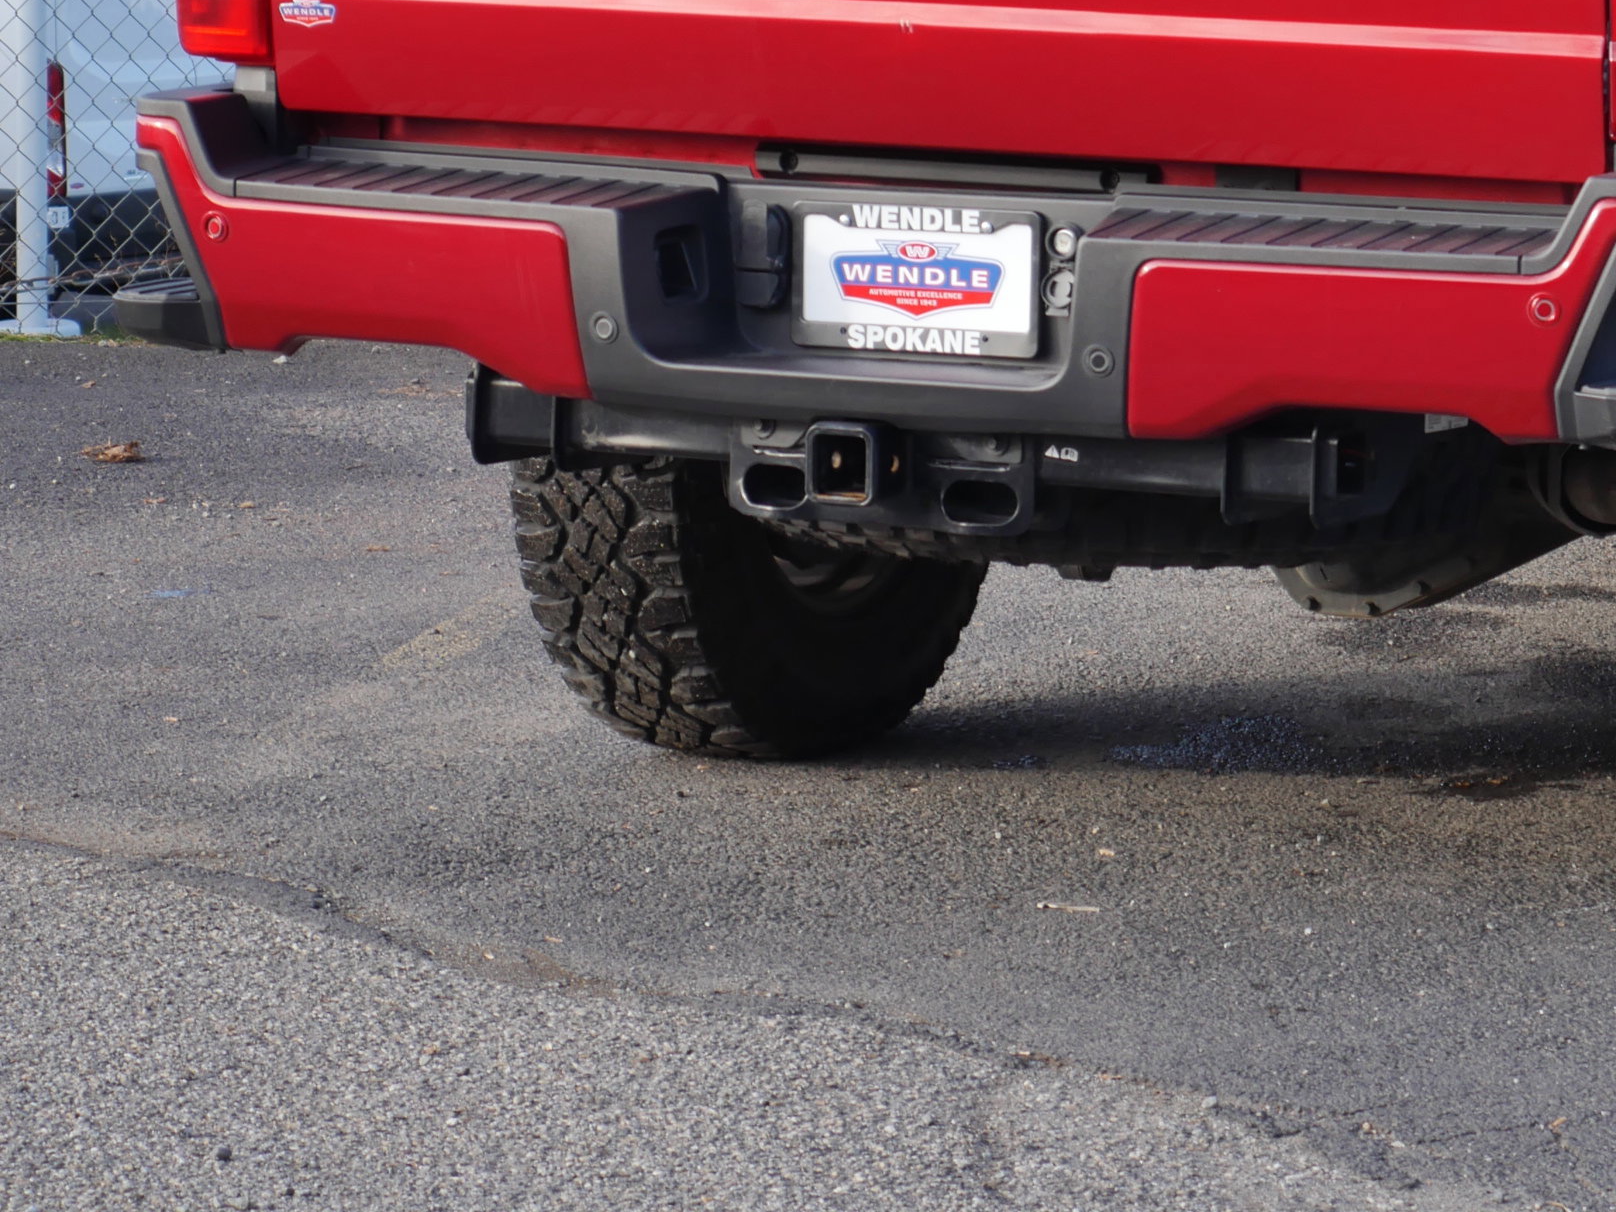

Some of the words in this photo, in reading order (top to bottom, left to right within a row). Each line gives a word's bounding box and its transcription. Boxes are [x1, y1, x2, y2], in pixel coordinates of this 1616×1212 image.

[283, 8, 330, 16] WENDLE
[852, 204, 981, 234] WENDLE
[842, 263, 989, 288] WENDLE
[869, 288, 916, 297] AUTOMOTIVE
[916, 290, 963, 300] EXCELLENCE
[896, 297, 918, 306] SINCE
[847, 325, 981, 356] SPOKANE
